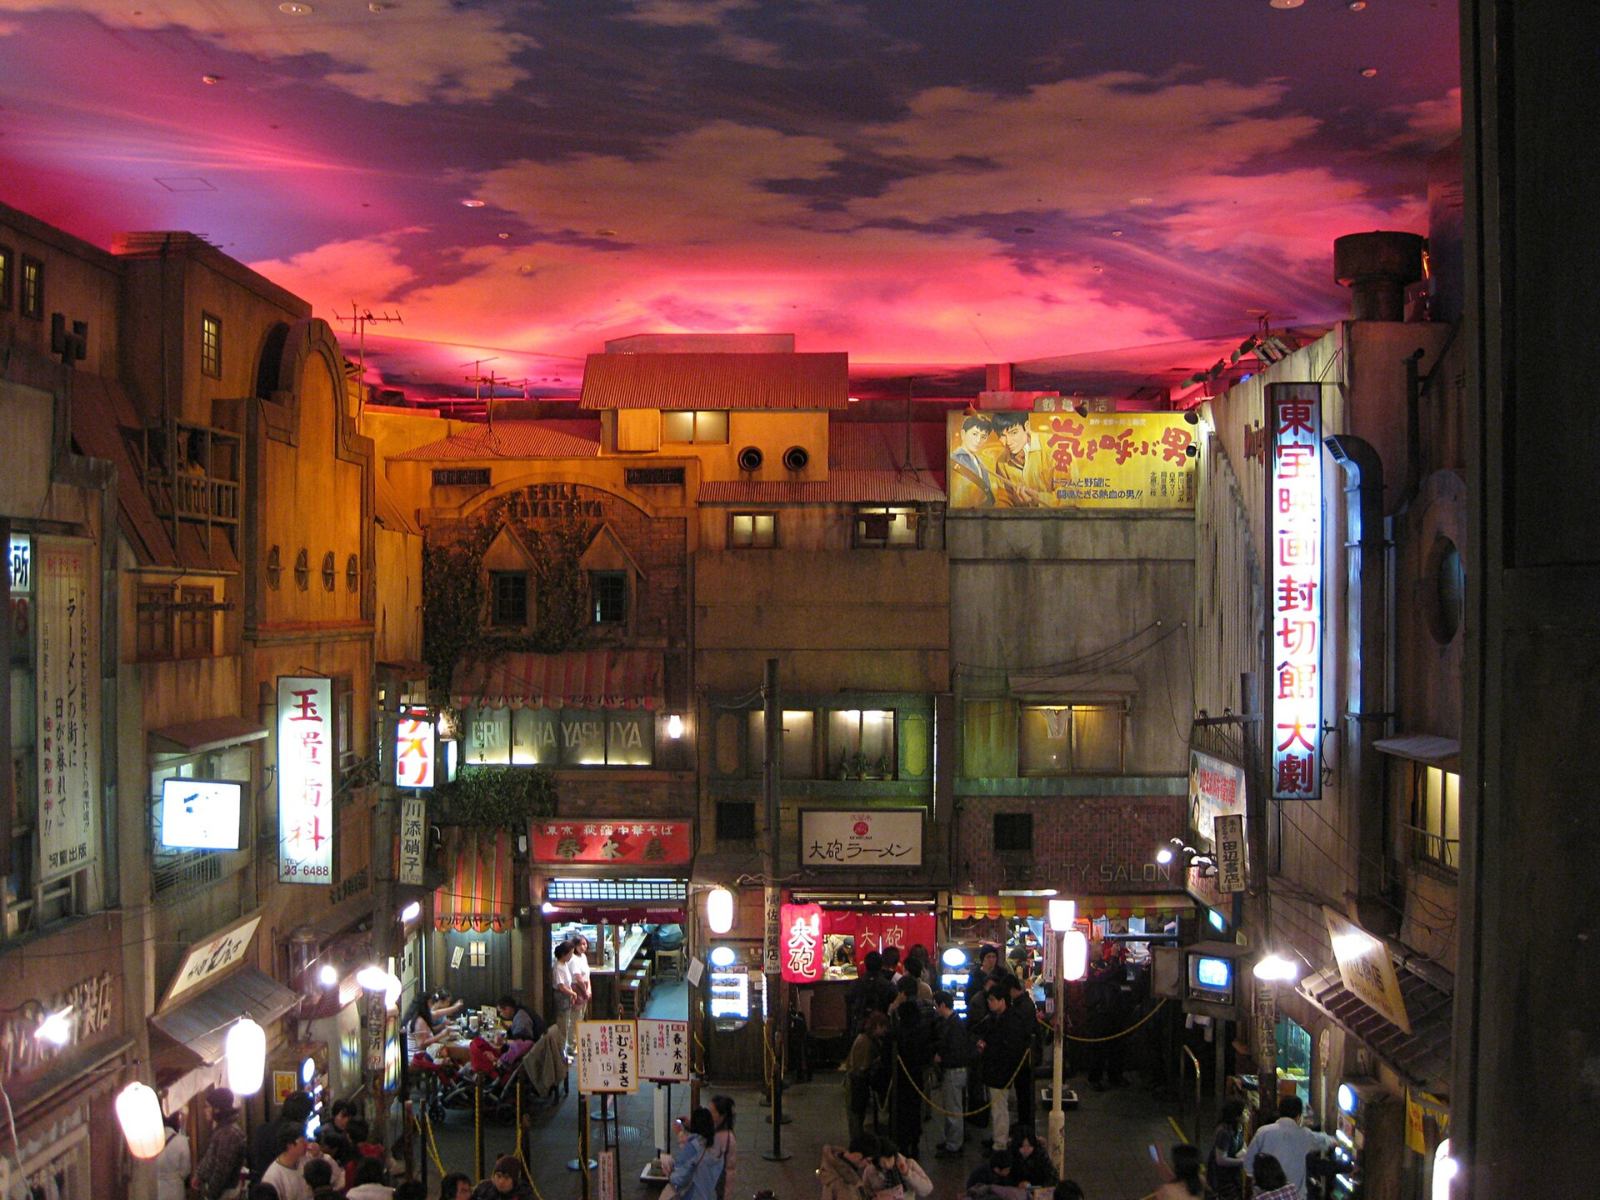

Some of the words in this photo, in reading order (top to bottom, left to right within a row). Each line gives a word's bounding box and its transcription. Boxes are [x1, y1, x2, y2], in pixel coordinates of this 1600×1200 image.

[808, 839, 913, 862] 大砲ラーメン
[1100, 864, 1171, 881] SALON
[788, 916, 817, 978] 大砲
[601, 1062, 612, 1072] 15
[616, 1034, 630, 1088] むらまさ
